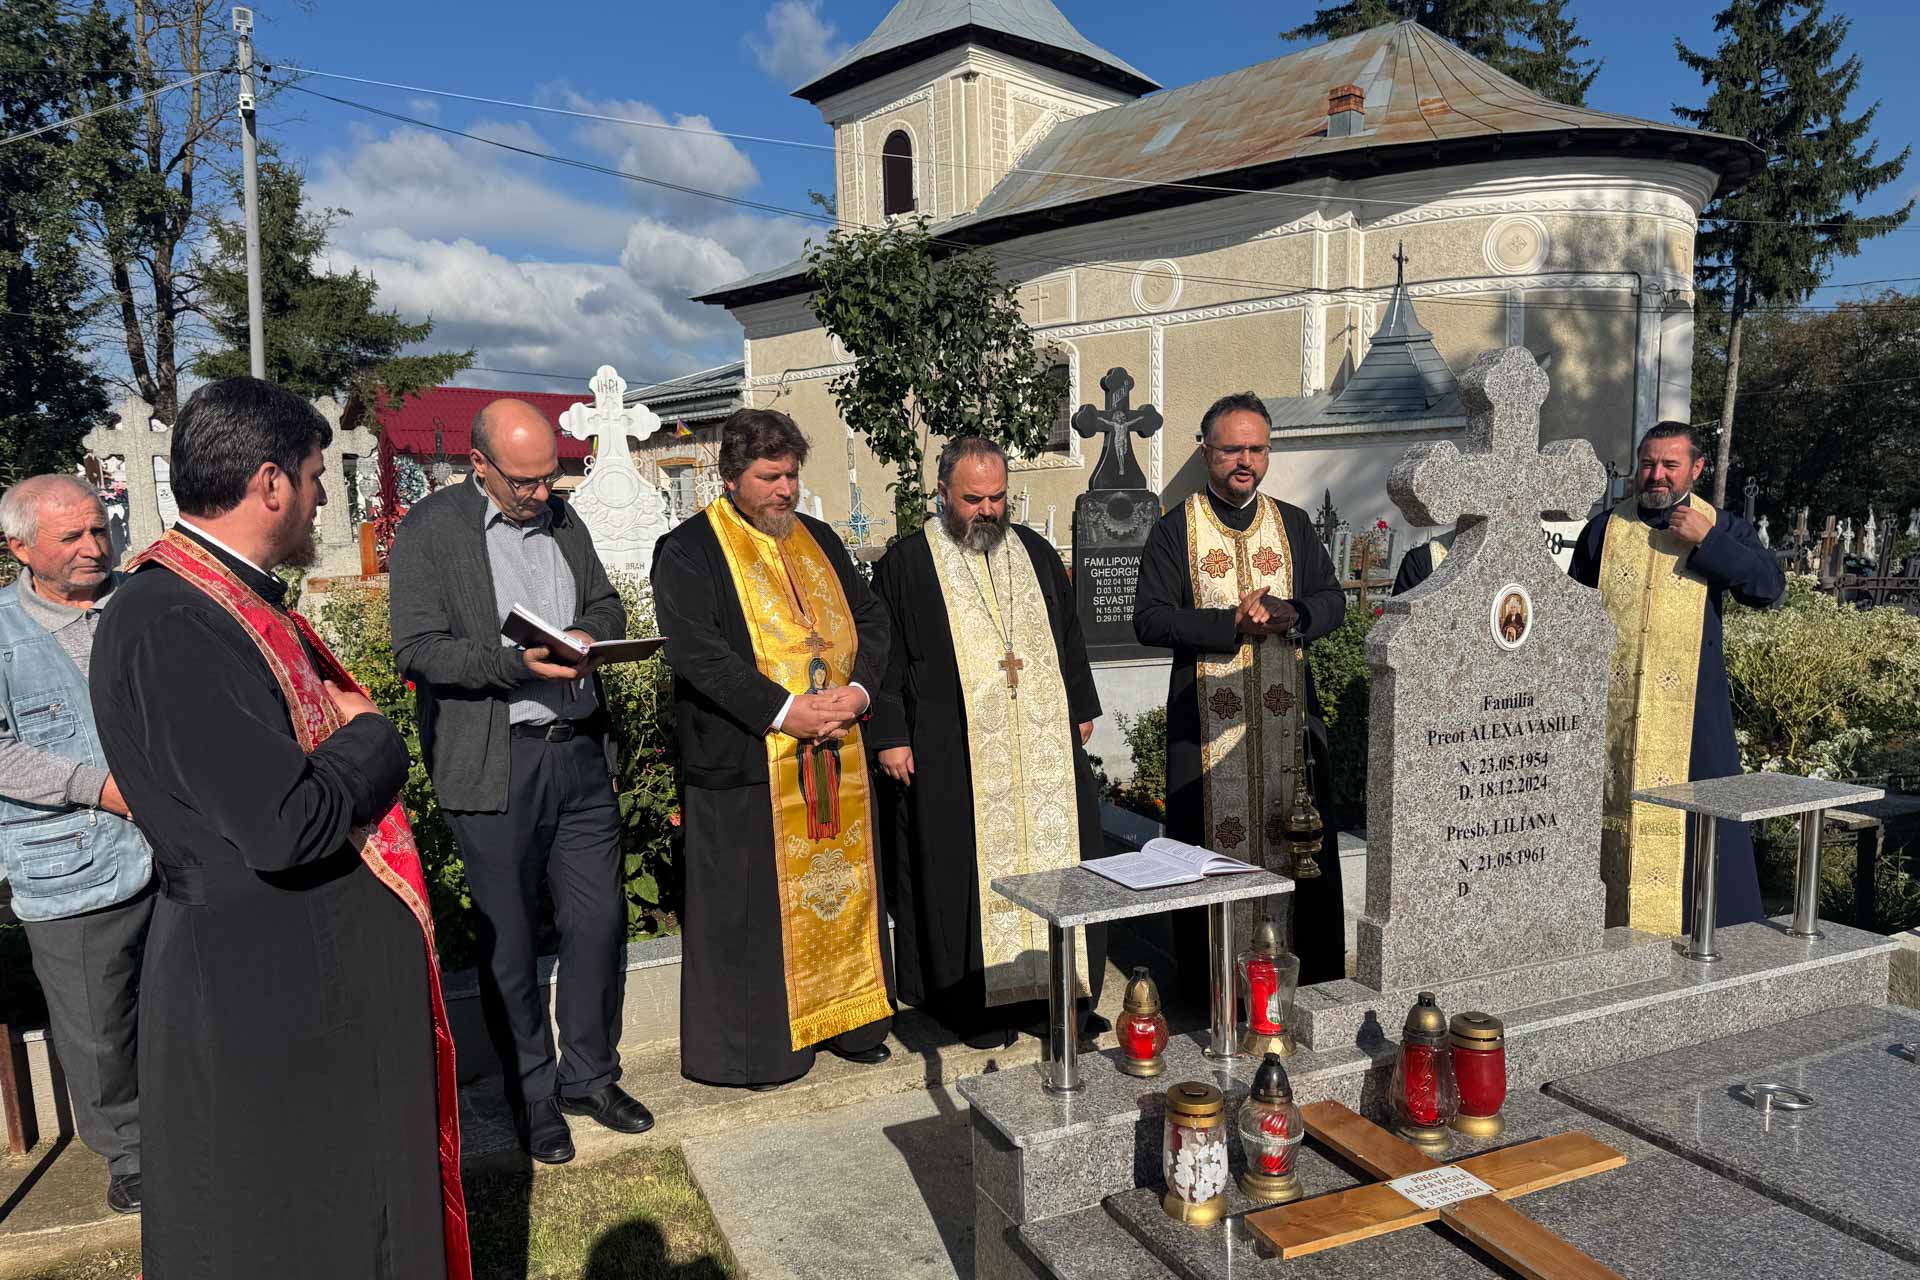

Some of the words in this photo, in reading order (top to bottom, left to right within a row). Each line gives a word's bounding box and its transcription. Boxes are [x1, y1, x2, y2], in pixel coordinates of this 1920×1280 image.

[1084, 556, 1142, 567] FAM.LIPOVA
[1090, 567, 1139, 578] GHEORGH
[1484, 692, 1534, 711] Familia
[1428, 729, 1465, 746] Preot
[1469, 721, 1524, 742] ALEXA
[1527, 714, 1580, 734] VASILE
[1460, 760, 1474, 775] N.
[1480, 751, 1548, 774] 23.05.1954
[1460, 784, 1473, 800] D.
[1480, 775, 1547, 798] 18.12.2024
[1447, 822, 1488, 841] Presb.
[1493, 813, 1557, 835] LILIANA
[1459, 859, 1472, 872] N.
[1404, 1182, 1437, 1195] ALEXA
[1434, 1173, 1471, 1185] VASILE
[1411, 1171, 1442, 1183] PREOT
